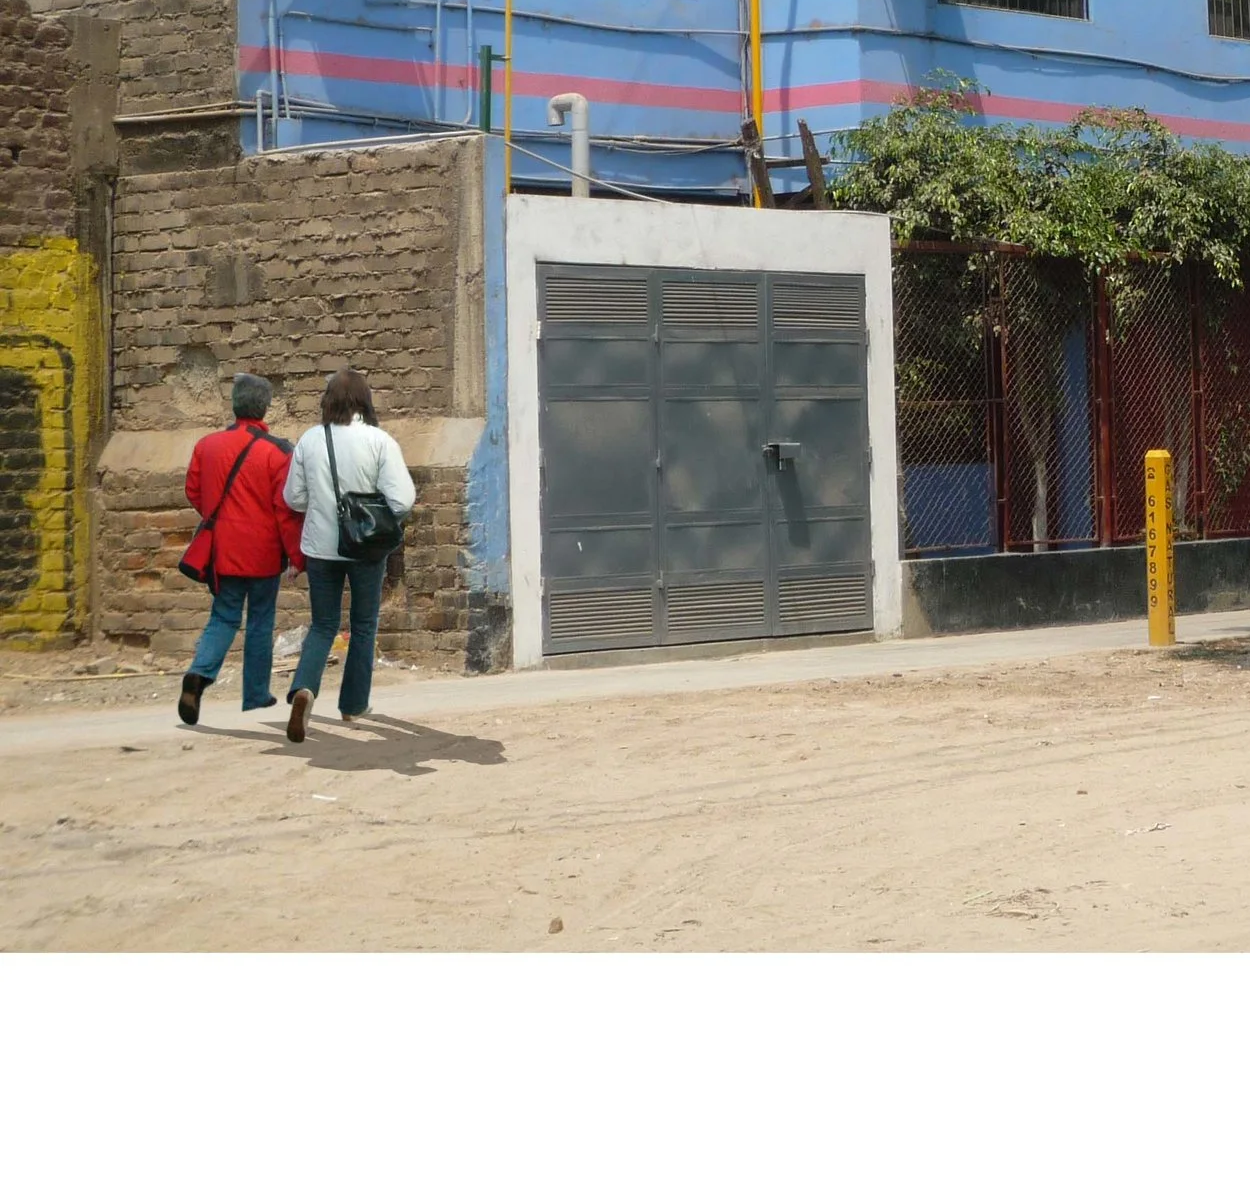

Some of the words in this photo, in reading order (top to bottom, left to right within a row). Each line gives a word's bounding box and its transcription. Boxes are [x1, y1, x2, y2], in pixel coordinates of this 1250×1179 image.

[1164, 463, 1173, 510] GAS
[1147, 494, 1158, 608] 6167899
[1166, 521, 1175, 635] NATURAL
